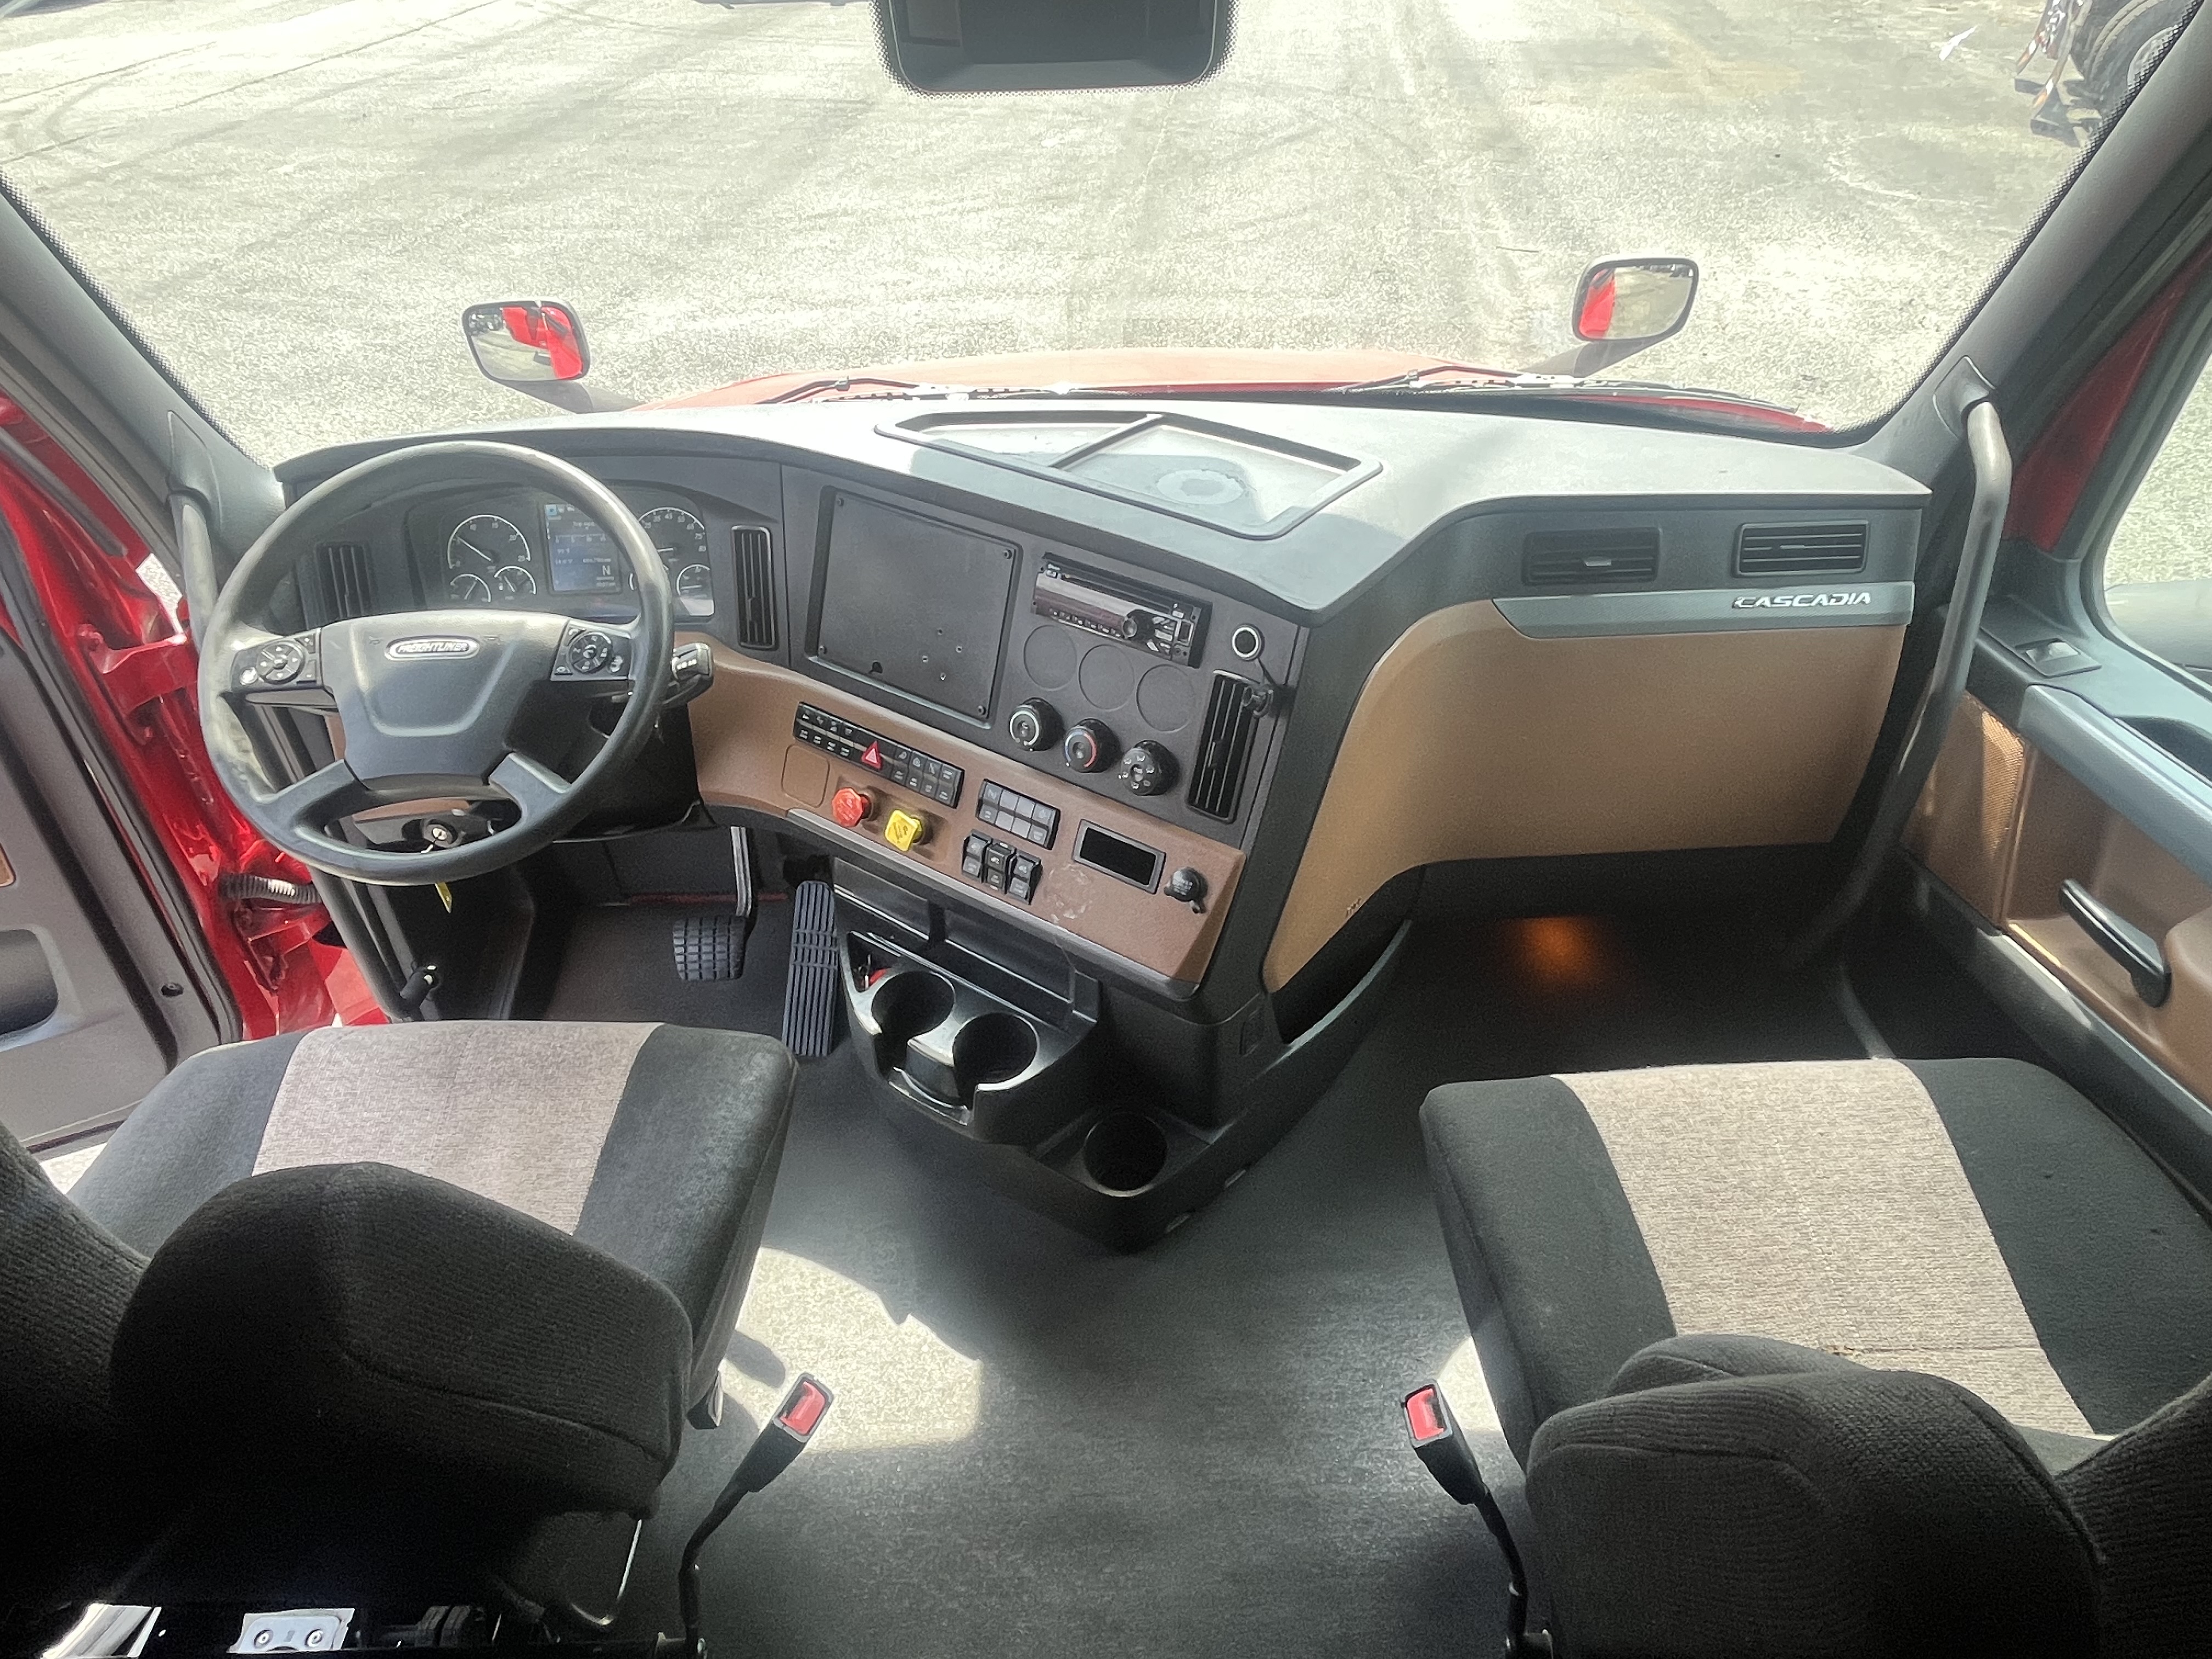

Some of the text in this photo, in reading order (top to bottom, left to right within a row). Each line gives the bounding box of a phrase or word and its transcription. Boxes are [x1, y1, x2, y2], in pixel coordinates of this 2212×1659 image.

[602, 565, 611, 575] N
[1733, 592, 1871, 608] CASCADIA
[397, 641, 469, 653] FREIGHTLINER
